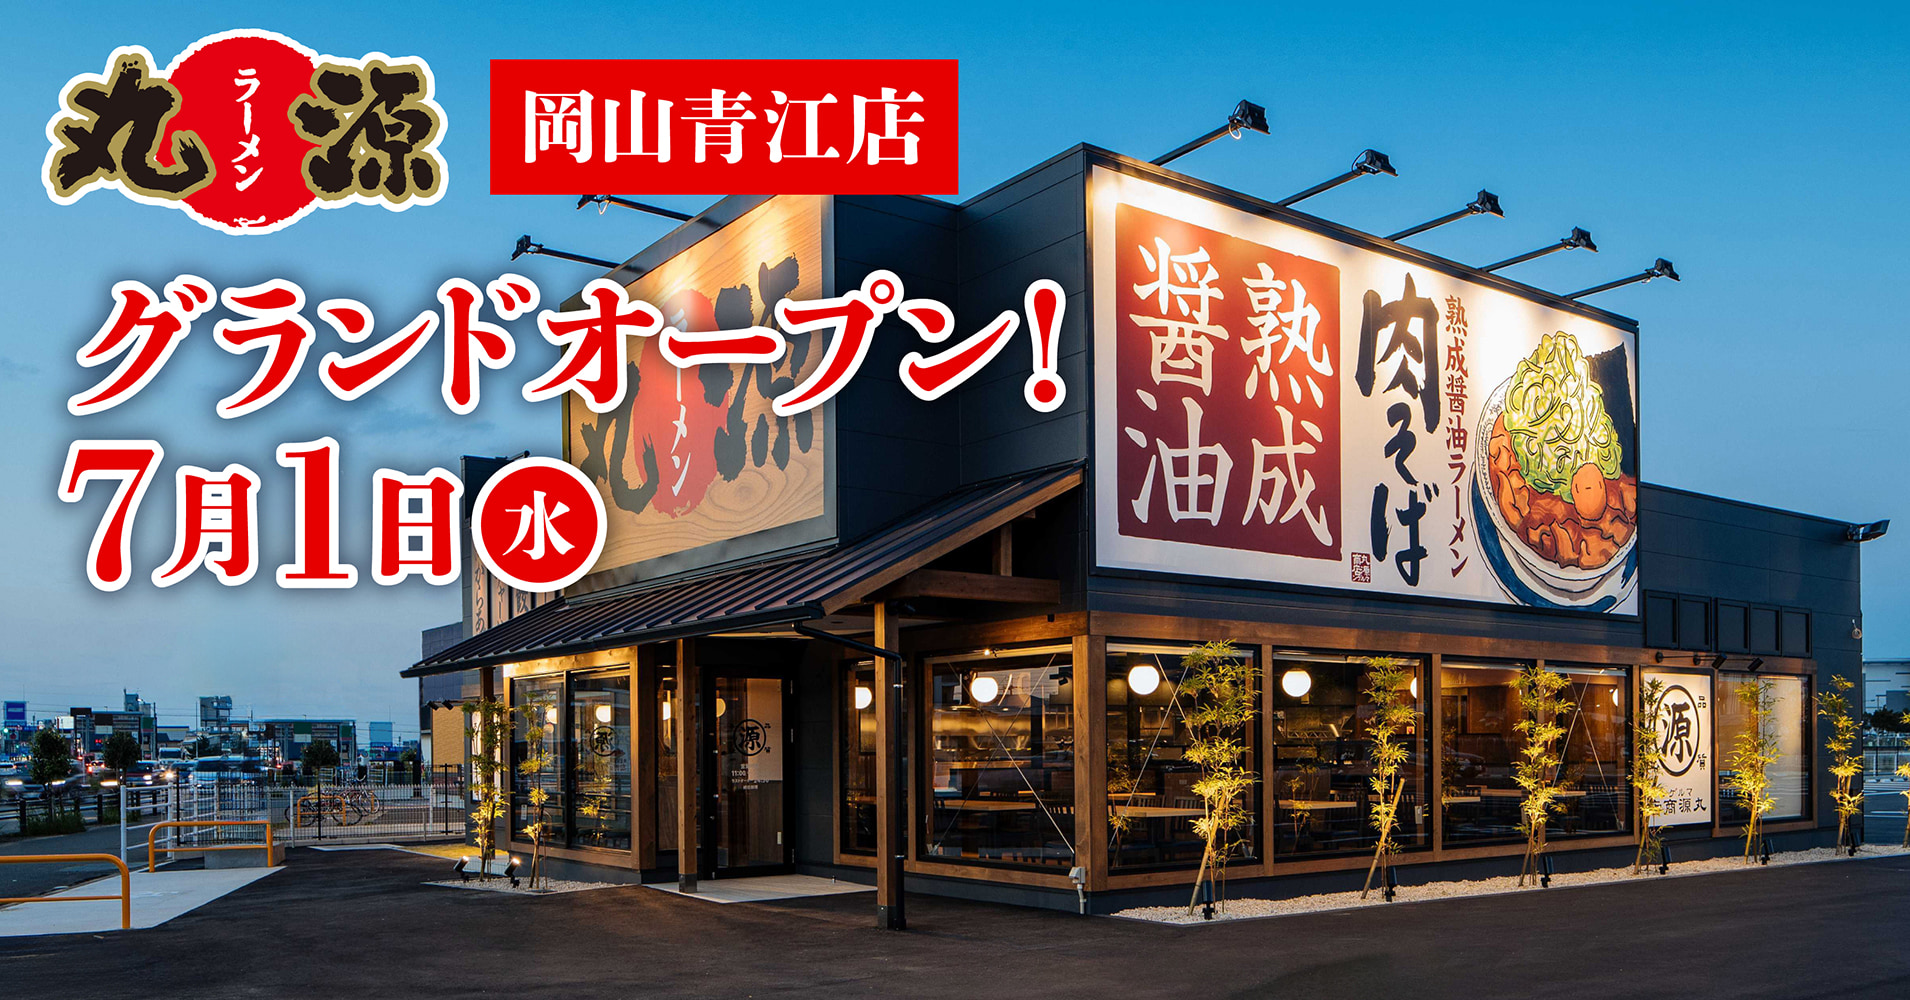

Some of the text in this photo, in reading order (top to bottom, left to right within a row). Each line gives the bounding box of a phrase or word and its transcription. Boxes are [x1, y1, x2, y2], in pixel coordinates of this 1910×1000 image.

[1125, 237, 1233, 526] 醤油
[1240, 262, 1333, 546] 熟成
[1355, 272, 1440, 586] 肉そば
[1445, 294, 1468, 578] 熟成醤油ラーメン
[739, 726, 761, 750] 源
[1661, 702, 1692, 763] 源
